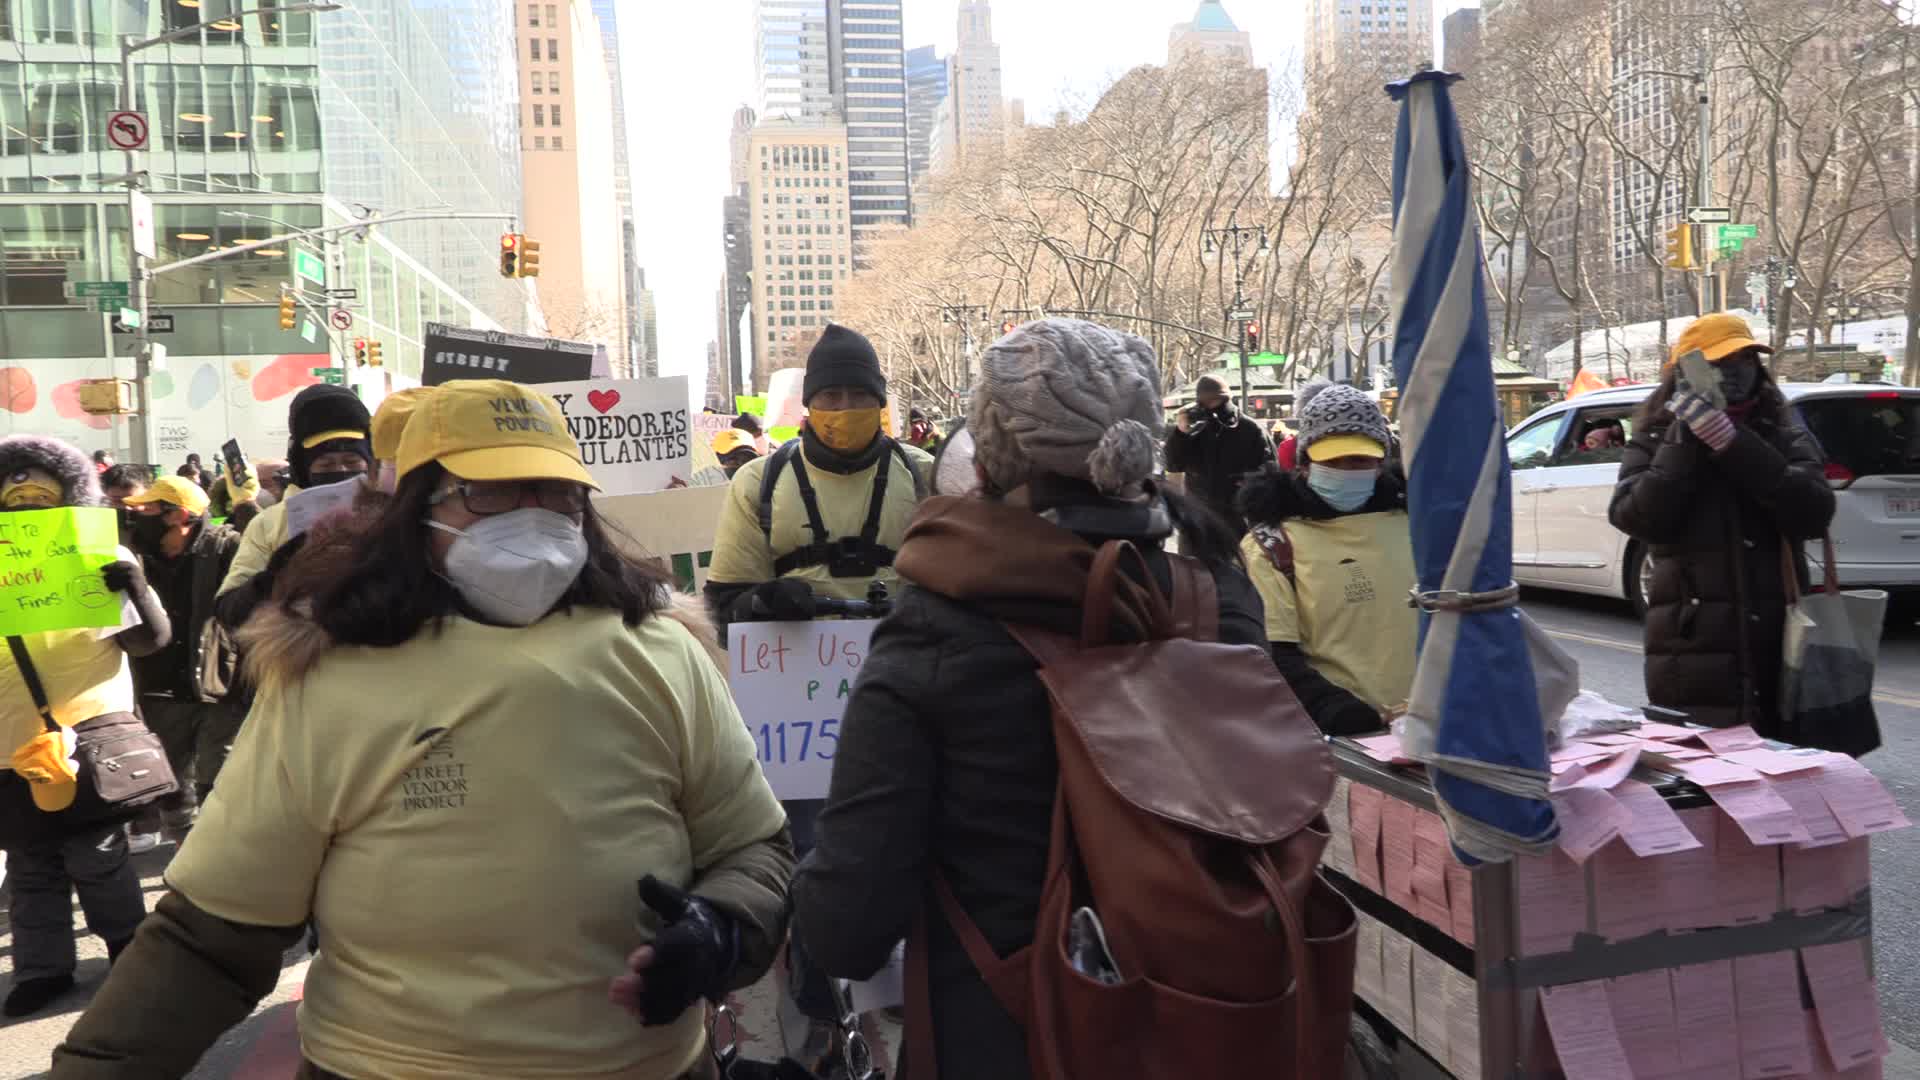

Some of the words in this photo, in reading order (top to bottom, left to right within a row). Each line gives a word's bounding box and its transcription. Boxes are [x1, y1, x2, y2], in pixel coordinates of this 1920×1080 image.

[565, 409, 687, 440] NDEDORES
[579, 433, 689, 465] ULANTES
[740, 633, 792, 674] Let
[818, 633, 861, 668] Us
[749, 718, 839, 763] 1175
[401, 763, 466, 780] STREET
[402, 779, 469, 796] VENDOR
[403, 793, 467, 811] PROJECT
